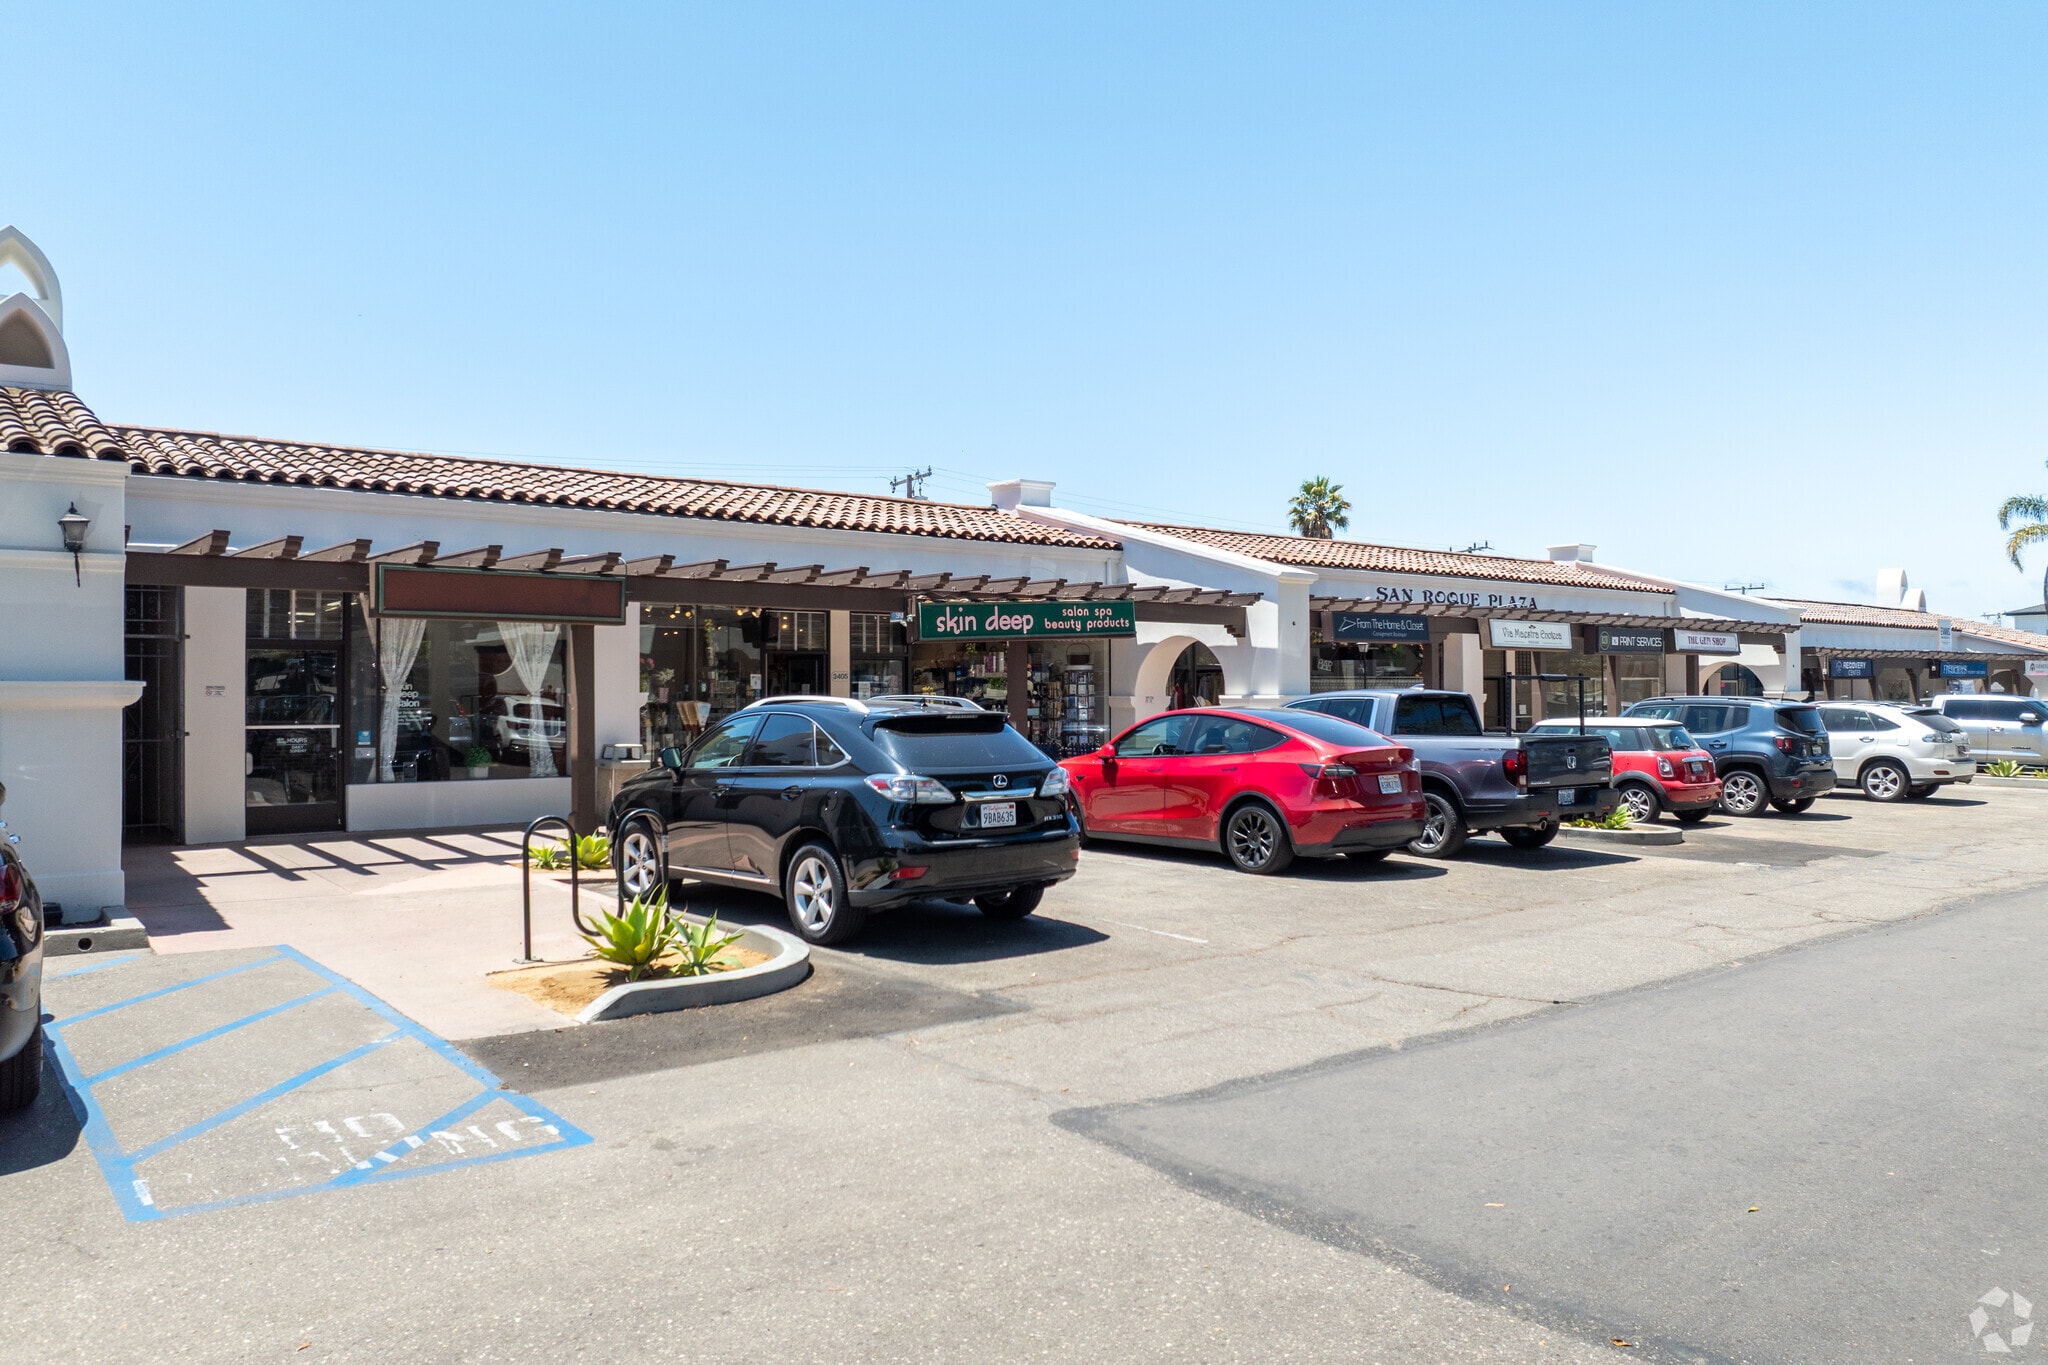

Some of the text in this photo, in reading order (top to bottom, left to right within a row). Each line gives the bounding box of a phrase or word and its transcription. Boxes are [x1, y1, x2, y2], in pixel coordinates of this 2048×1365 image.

[1376, 586, 1538, 610] SAN ROQUE PLAZA
[1062, 605, 1113, 619] salon spa
[936, 605, 1034, 635] skin deep
[1044, 617, 1130, 632] beauty products
[1356, 618, 1372, 629] From
[1371, 618, 1382, 629] The
[1382, 619, 1400, 630] Home
[1406, 619, 1424, 631] Closet
[1619, 636, 1636, 646] PRINT
[1636, 636, 1662, 647] SERVICES
[1687, 636, 1698, 645] THE
[983, 811, 1015, 825] 9BAB635
